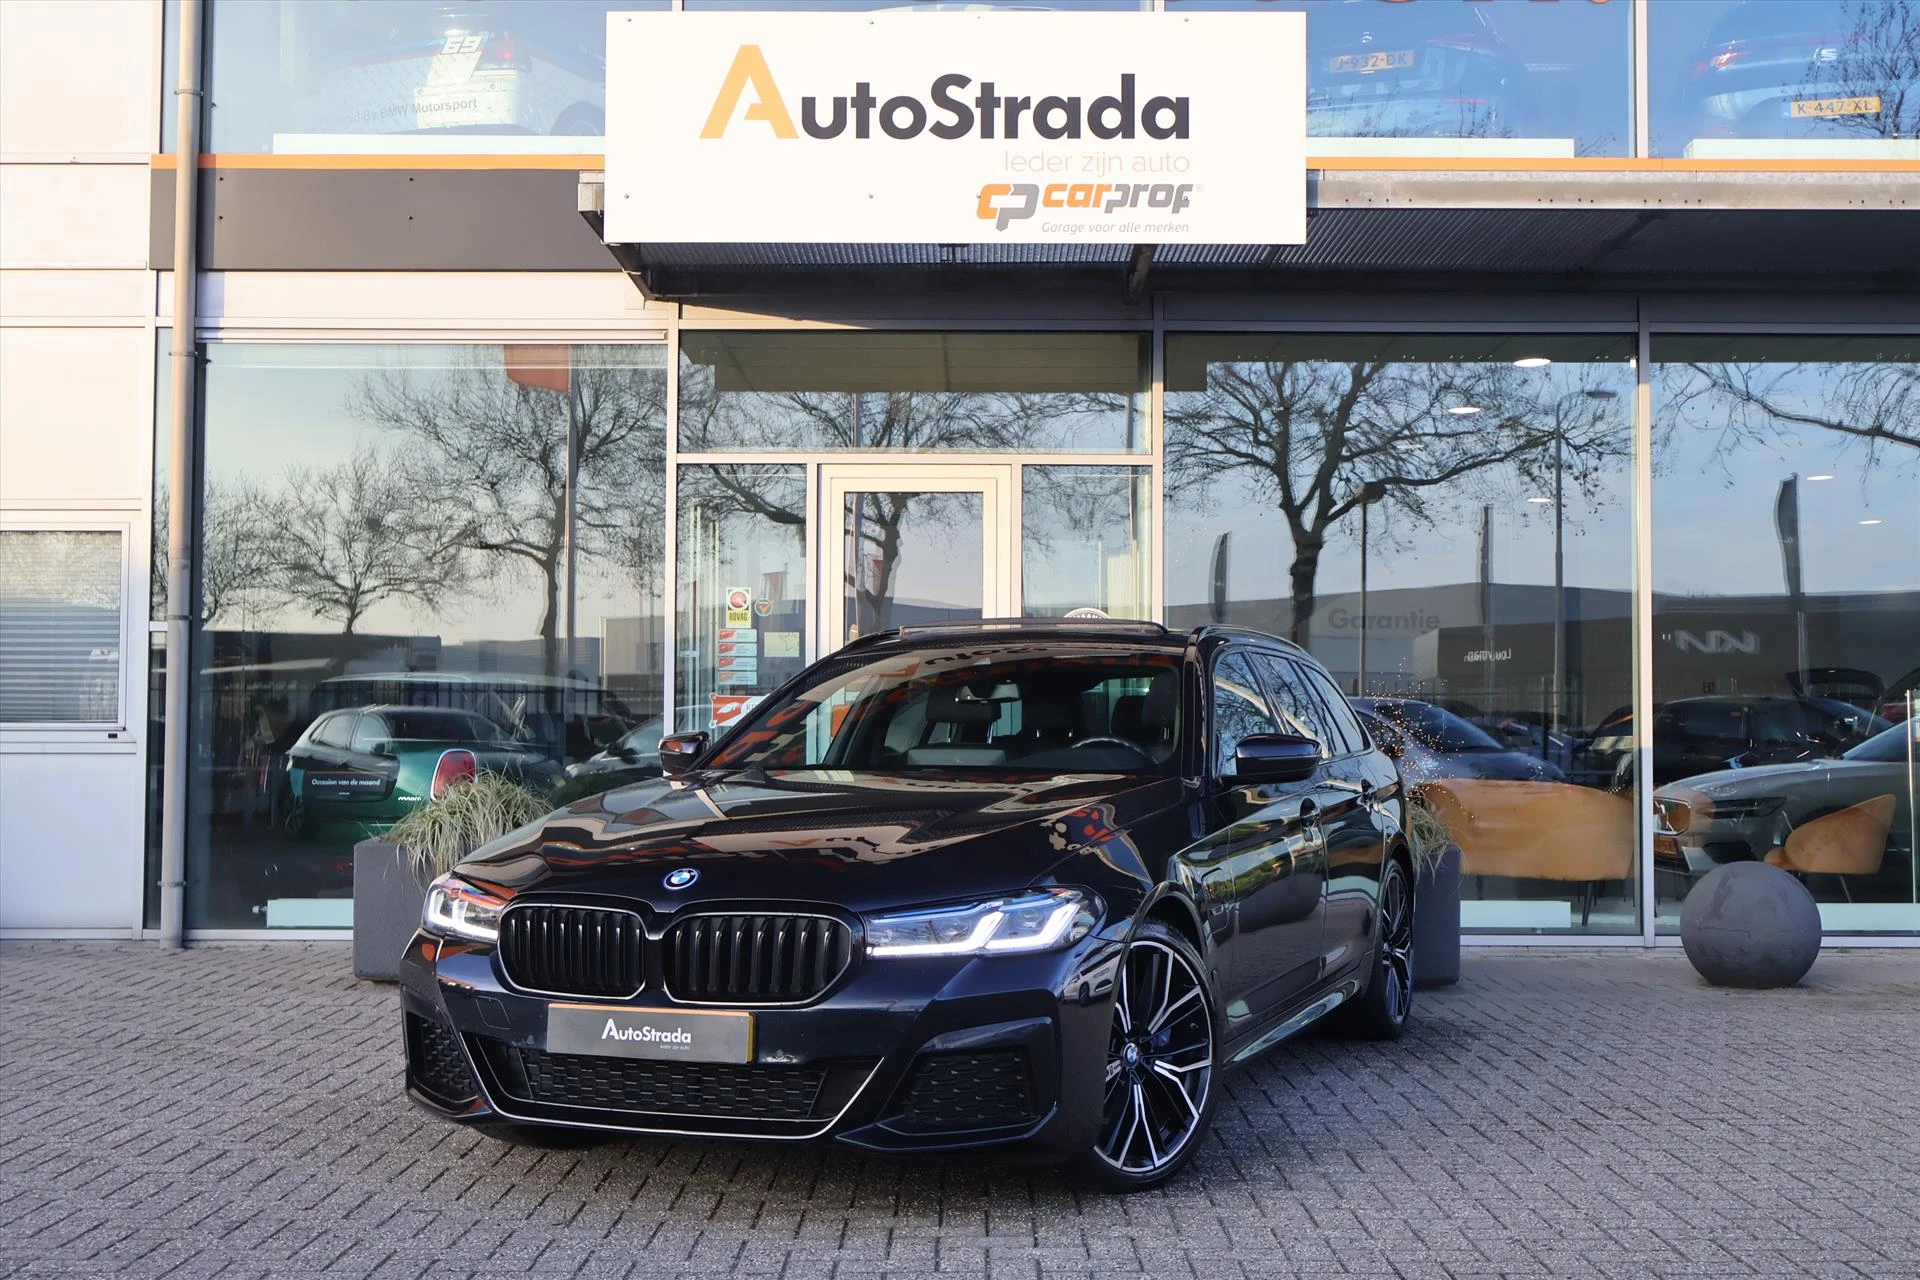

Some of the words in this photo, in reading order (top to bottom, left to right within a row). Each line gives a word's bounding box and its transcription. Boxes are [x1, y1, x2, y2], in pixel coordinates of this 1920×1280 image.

[440, 36, 482, 55] 69
[699, 44, 1190, 140] AutoStrada
[380, 105, 409, 118] BMW
[411, 98, 477, 114] Motorsport
[1004, 151, 1073, 172] Ieder
[1081, 155, 1129, 177] zijn
[1132, 153, 1191, 172] auto
[1042, 183, 1194, 214] carprof
[1041, 221, 1085, 235] Garage
[1088, 224, 1117, 233] voor
[1118, 221, 1141, 233] alle
[1144, 221, 1189, 233] merken
[728, 611, 748, 622] BOVAG
[1327, 608, 1441, 631] Garantie
[350, 778, 358, 786] de
[358, 778, 380, 786] maand
[601, 1018, 692, 1043] AutoStrada
